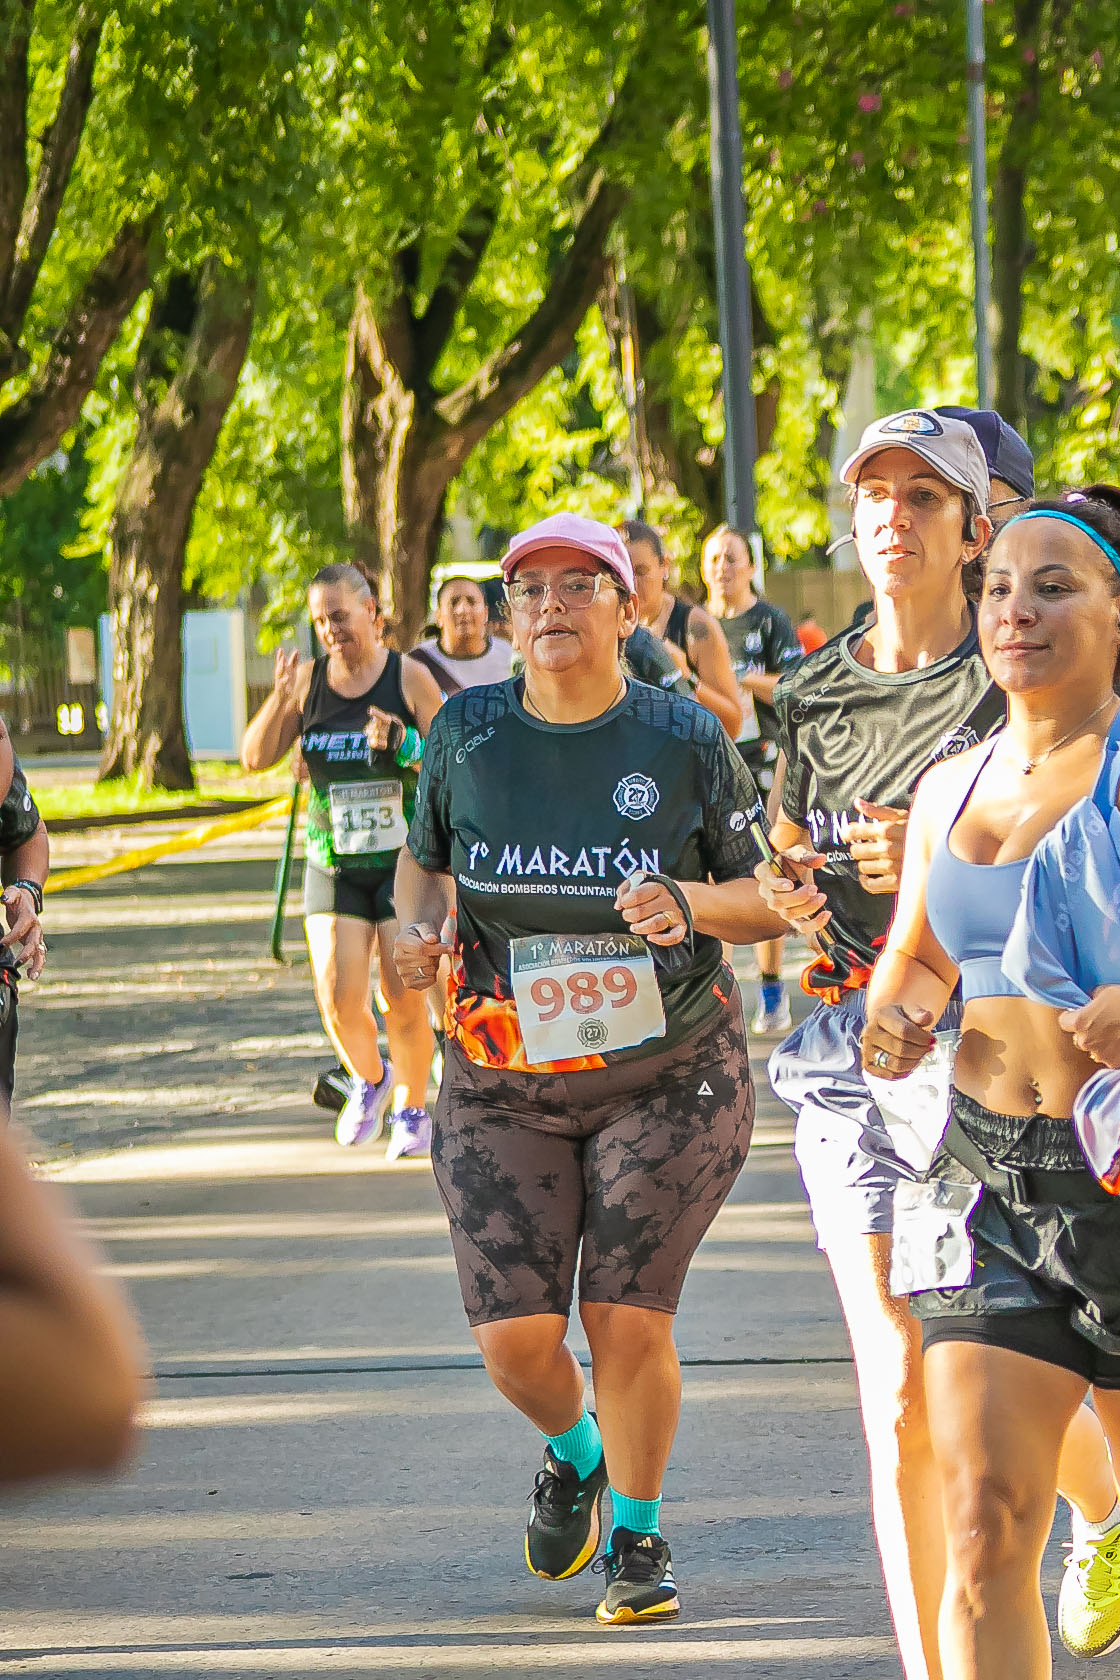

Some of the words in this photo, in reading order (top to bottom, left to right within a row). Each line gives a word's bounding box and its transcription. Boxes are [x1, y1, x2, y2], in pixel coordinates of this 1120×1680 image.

[342, 807, 395, 832] 153
[495, 837, 660, 878] MARATÓN
[458, 872, 500, 894] ASOCIACIÓN
[500, 884, 559, 895] BOMBEROS
[559, 885, 618, 898] VOLUNTARI
[549, 937, 630, 956] MARATÓN
[530, 965, 638, 1022] 989
[584, 1028, 600, 1039] 27
